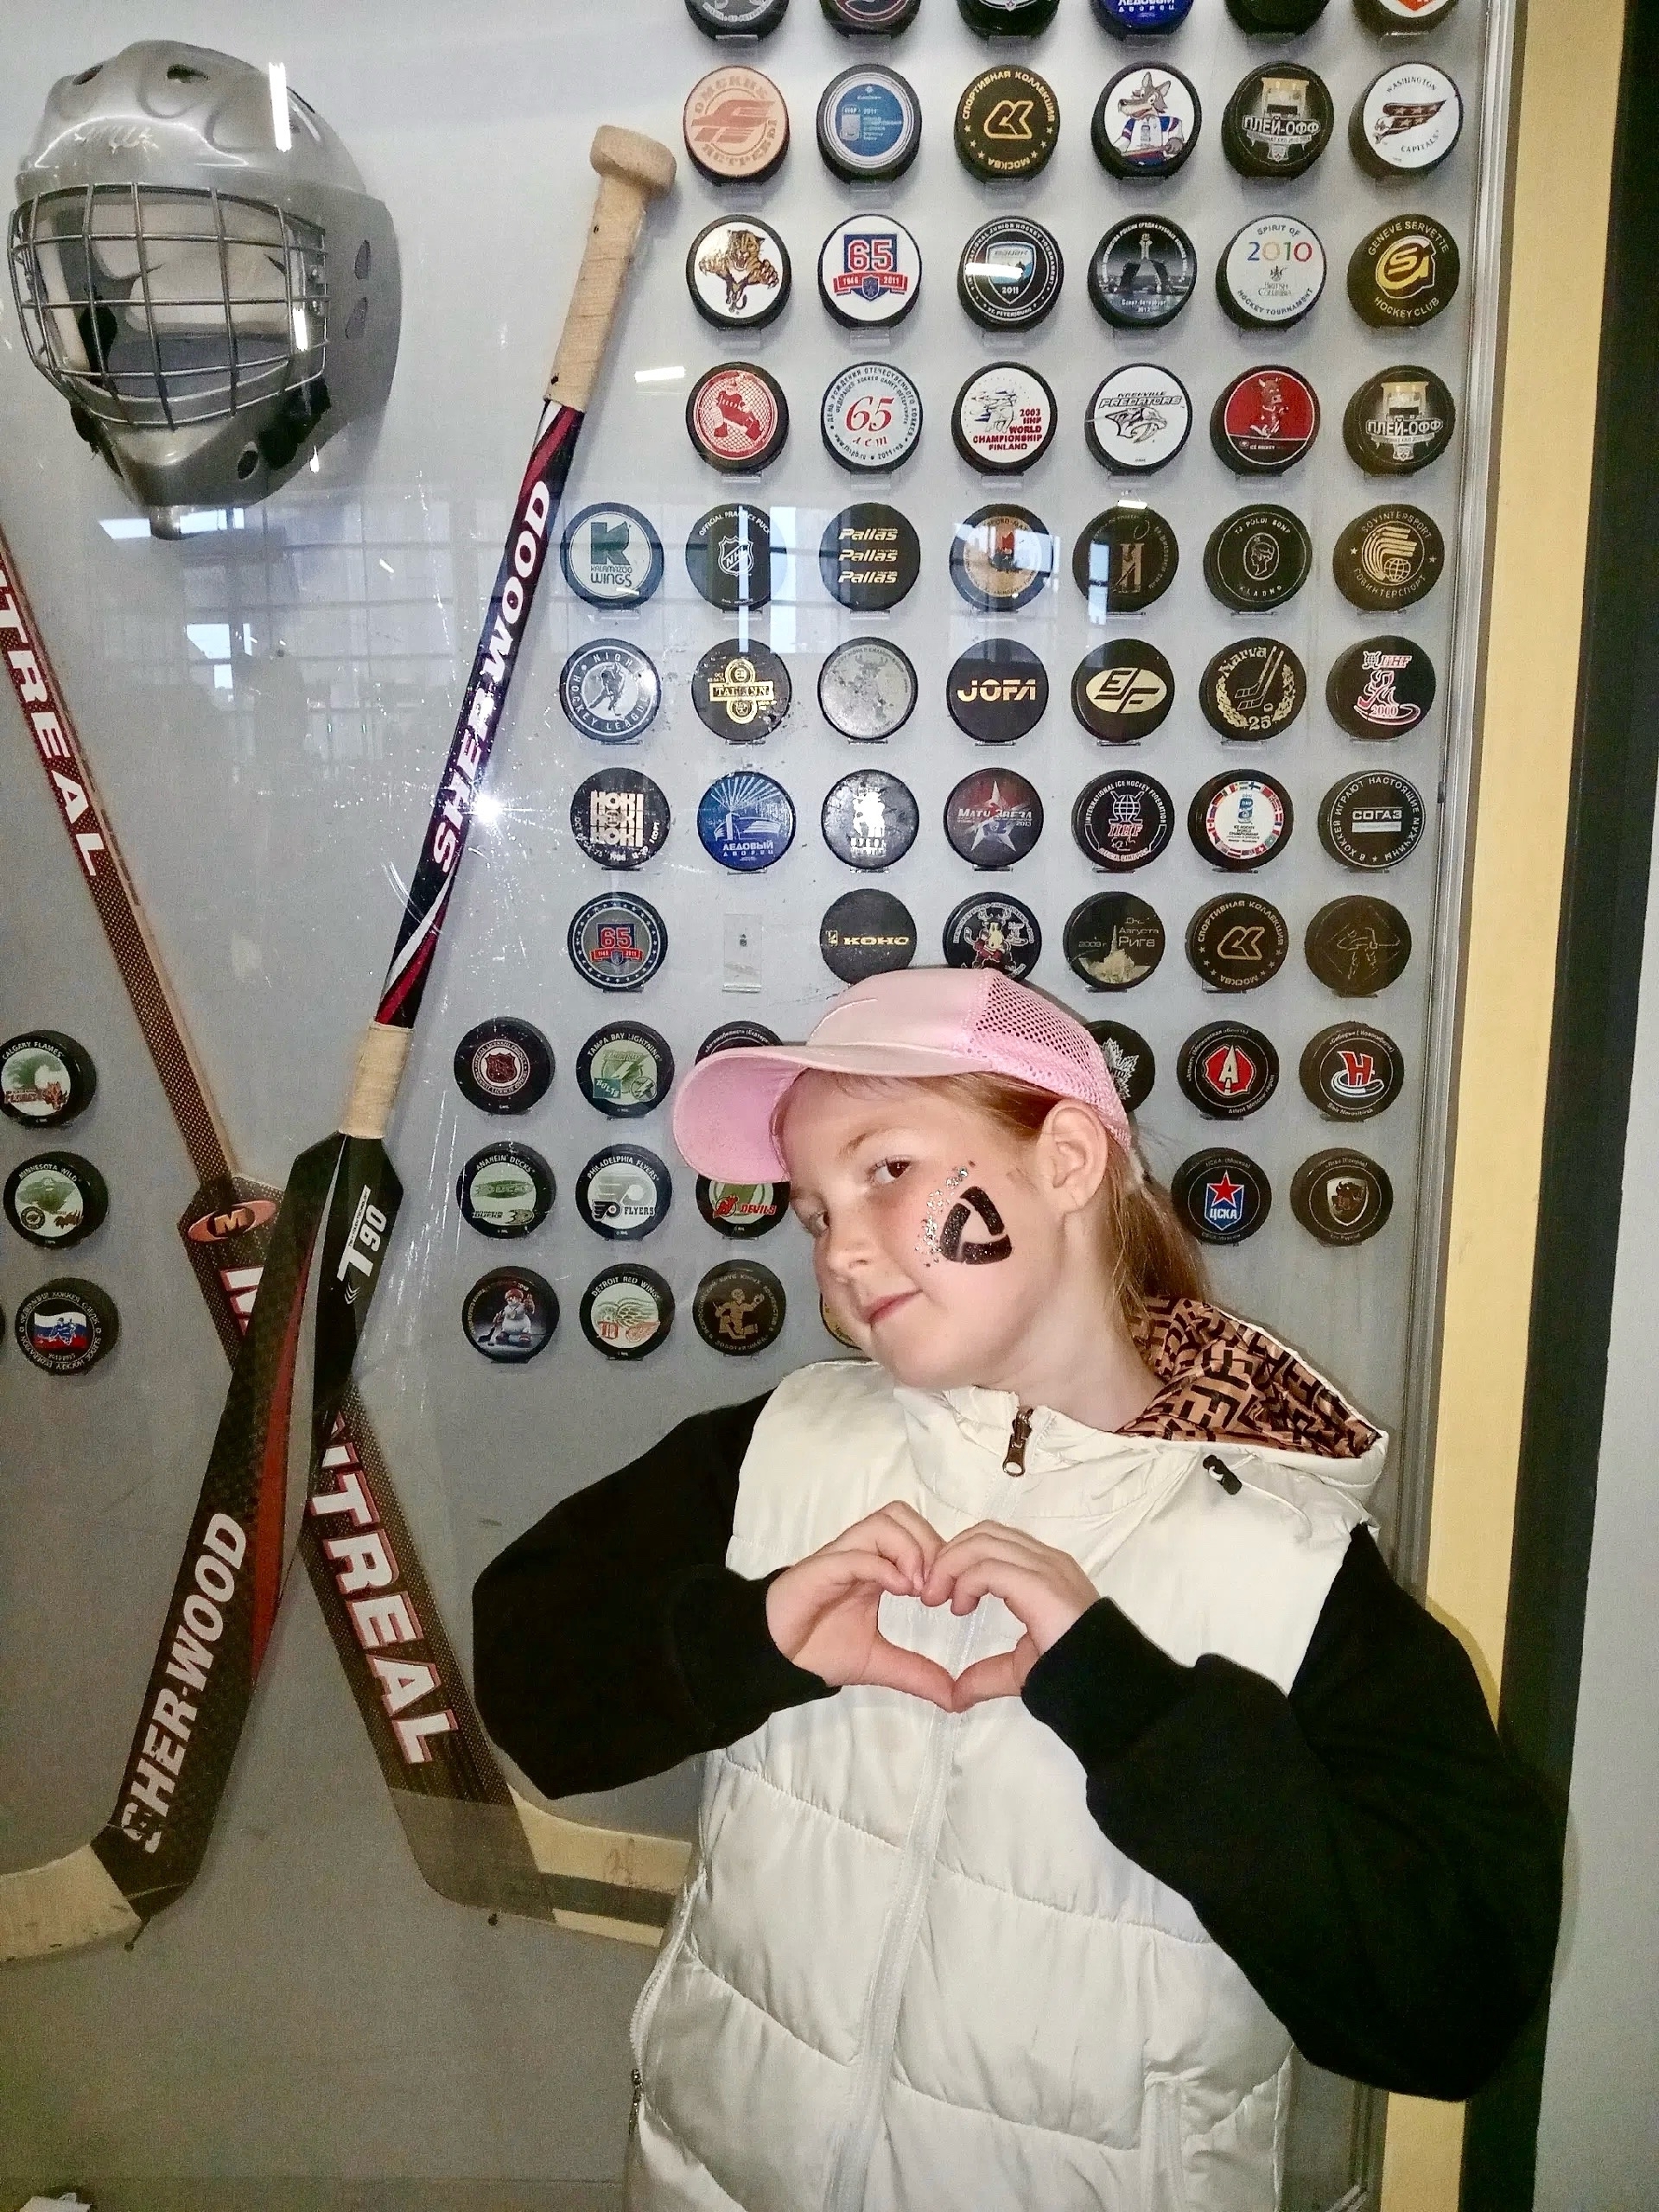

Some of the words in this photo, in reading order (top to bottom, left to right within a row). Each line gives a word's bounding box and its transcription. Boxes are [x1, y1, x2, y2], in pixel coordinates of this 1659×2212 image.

[1386, 75, 1438, 93] WASHINGTON
[962, 70, 1011, 120] СПОРТИВНАЯ
[1014, 71, 1056, 122] КОЛЛЕКЦИЯ
[1244, 116, 1319, 136] ПЛЕЙ-ОФФ
[1401, 130, 1440, 153] CAPITALS
[987, 156, 1031, 171] МОСКВА
[1256, 225, 1287, 236] SPIRIT
[1289, 227, 1301, 237] OF
[1368, 221, 1402, 257] GENEVE
[1404, 220, 1450, 253] SERVETTE
[848, 238, 893, 271] 65
[1246, 241, 1313, 263] 2010
[1237, 289, 1264, 314] HOCKEY
[1265, 287, 1313, 315] TOURNAMENT
[1374, 296, 1413, 318] HOCKEY
[1414, 296, 1440, 317] CLUB
[1098, 395, 1183, 409] PREDATORS
[846, 395, 895, 432] 65
[1020, 408, 1041, 416] 2003
[1009, 425, 1042, 434] WORLD
[1368, 418, 1441, 436] ПЛЕЙ-ОФФ
[972, 434, 1043, 443] CHAMPIONSHIP
[698, 513, 724, 537] OFFICIAL
[1361, 510, 1432, 539] SOVINTERSPORT
[838, 528, 899, 542] Pallas
[838, 549, 899, 563] Pallas
[590, 565, 633, 574] KALAMAZOO
[838, 570, 899, 584] Pallas
[590, 574, 632, 588] WINGS
[1239, 584, 1283, 598] KLADNO
[1217, 645, 1268, 677] Narva
[715, 685, 768, 696] TALLINN
[957, 678, 1037, 702] JOFA
[1370, 704, 1398, 717] 2000
[0, 570, 106, 876] TREAL
[1249, 715, 1272, 731] 25
[1085, 783, 1115, 823] INTERNATIONAL
[1126, 780, 1150, 792] HOCKEY
[1148, 789, 1166, 823] FEDERATION
[1334, 780, 1363, 816] ИГРАЮТ
[1368, 777, 1420, 814] НАСТОЯЩИЕ
[1351, 809, 1402, 821] СОГАЗ
[1108, 823, 1143, 837] IIHF
[1335, 819, 1357, 855] ХОККЕЙ
[1384, 817, 1421, 861] МУЖЧИНЫ
[722, 841, 774, 851] ЛЕДОВЫЙ
[1198, 900, 1245, 943] СПОРТИВНАЯ
[1249, 901, 1284, 946] КОЛЛЕКЦИЯ
[600, 926, 632, 949] 65
[843, 936, 910, 946] KOHO
[1118, 936, 1155, 948] Рига
[2, 1041, 31, 1060] CALGARY
[34, 1041, 63, 1058] FLAMES
[588, 1037, 609, 1057] TAMPA
[610, 1033, 625, 1041] BAY
[627, 1033, 661, 1060] LIGHTNING
[596, 1079, 620, 1097] BOLTS
[19, 1164, 58, 1180] MINNESOTA
[60, 1166, 79, 1183] WILD
[510, 1156, 532, 1173] DUCKS
[588, 1155, 633, 1179] PHILADELPHIA
[636, 1160, 658, 1181] FLYERS
[624, 1206, 655, 1217] FLYERS
[740, 1204, 778, 1216] DEVILS
[1210, 1208, 1237, 1220] ЦСКА
[336, 1185, 387, 1282] T90
[591, 1276, 620, 1297] DETROIT
[640, 1281, 661, 1300] WINGS
